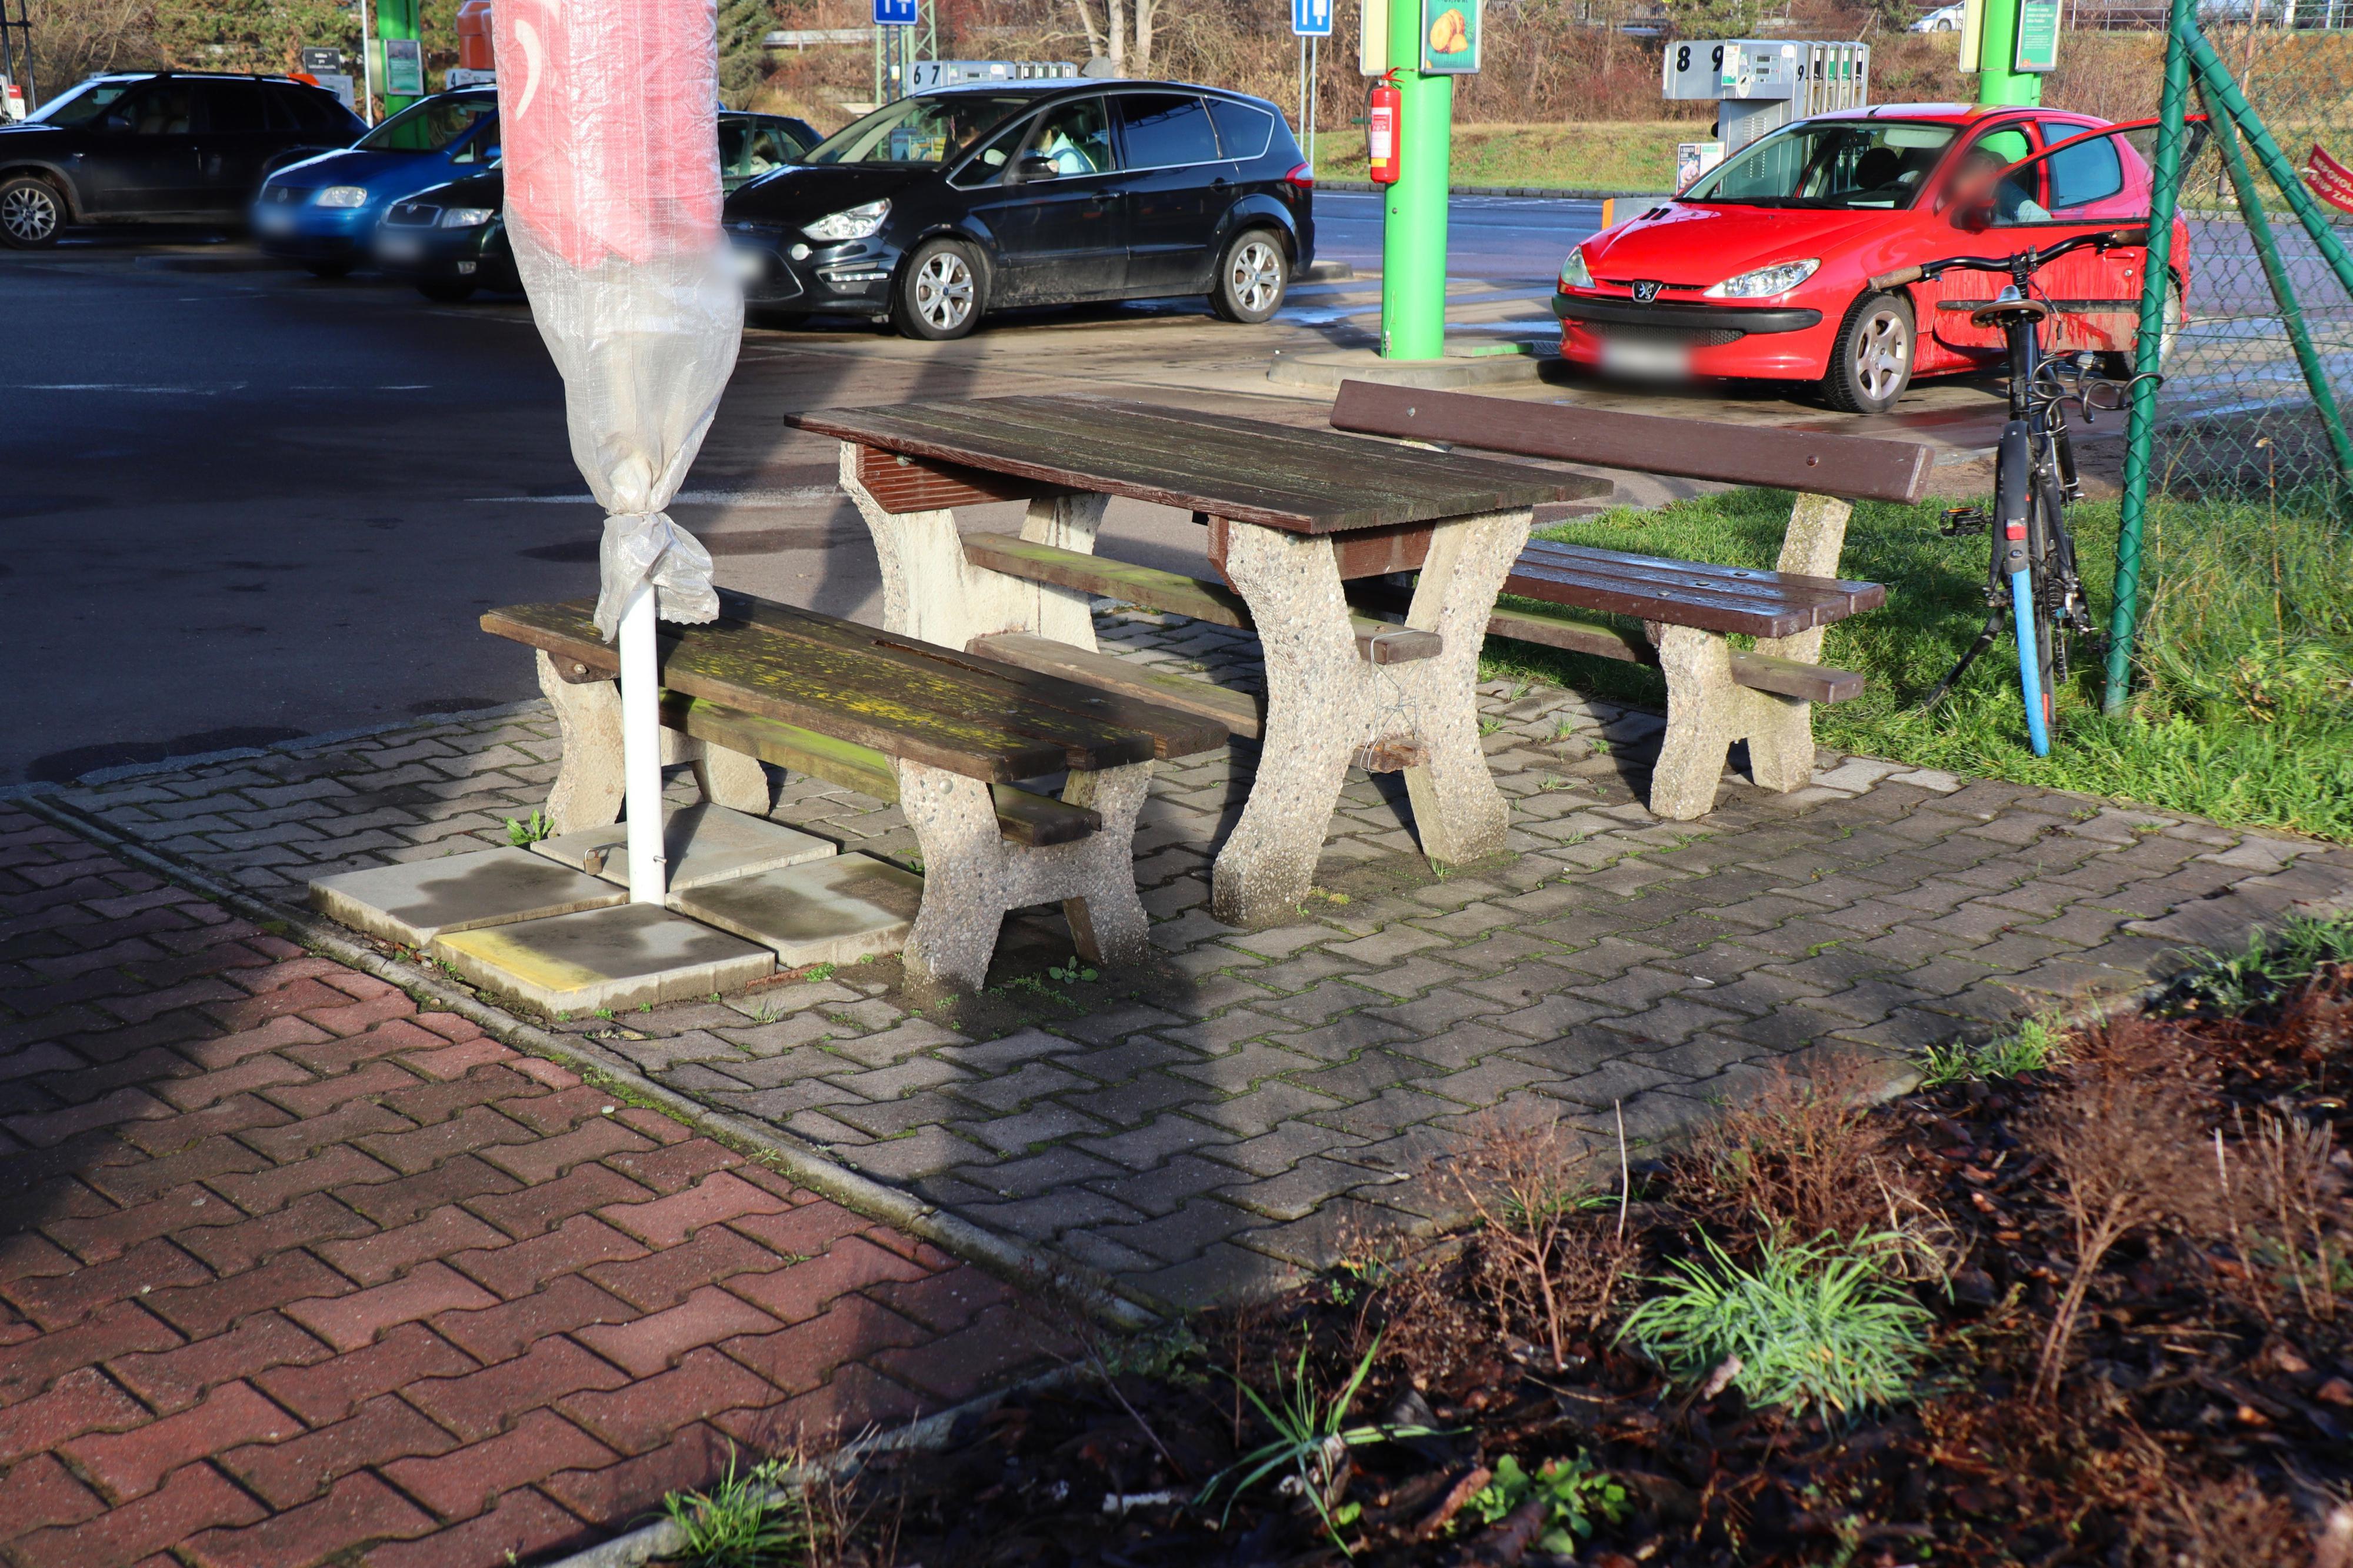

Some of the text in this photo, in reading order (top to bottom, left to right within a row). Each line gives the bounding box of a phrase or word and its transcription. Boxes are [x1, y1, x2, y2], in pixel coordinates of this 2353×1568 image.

[1677, 45, 1724, 72] 8 9
[451, 72, 456, 86] 4
[914, 65, 941, 85] 6 7
[1798, 65, 1804, 81] 9
[2310, 173, 2333, 192] STUP
